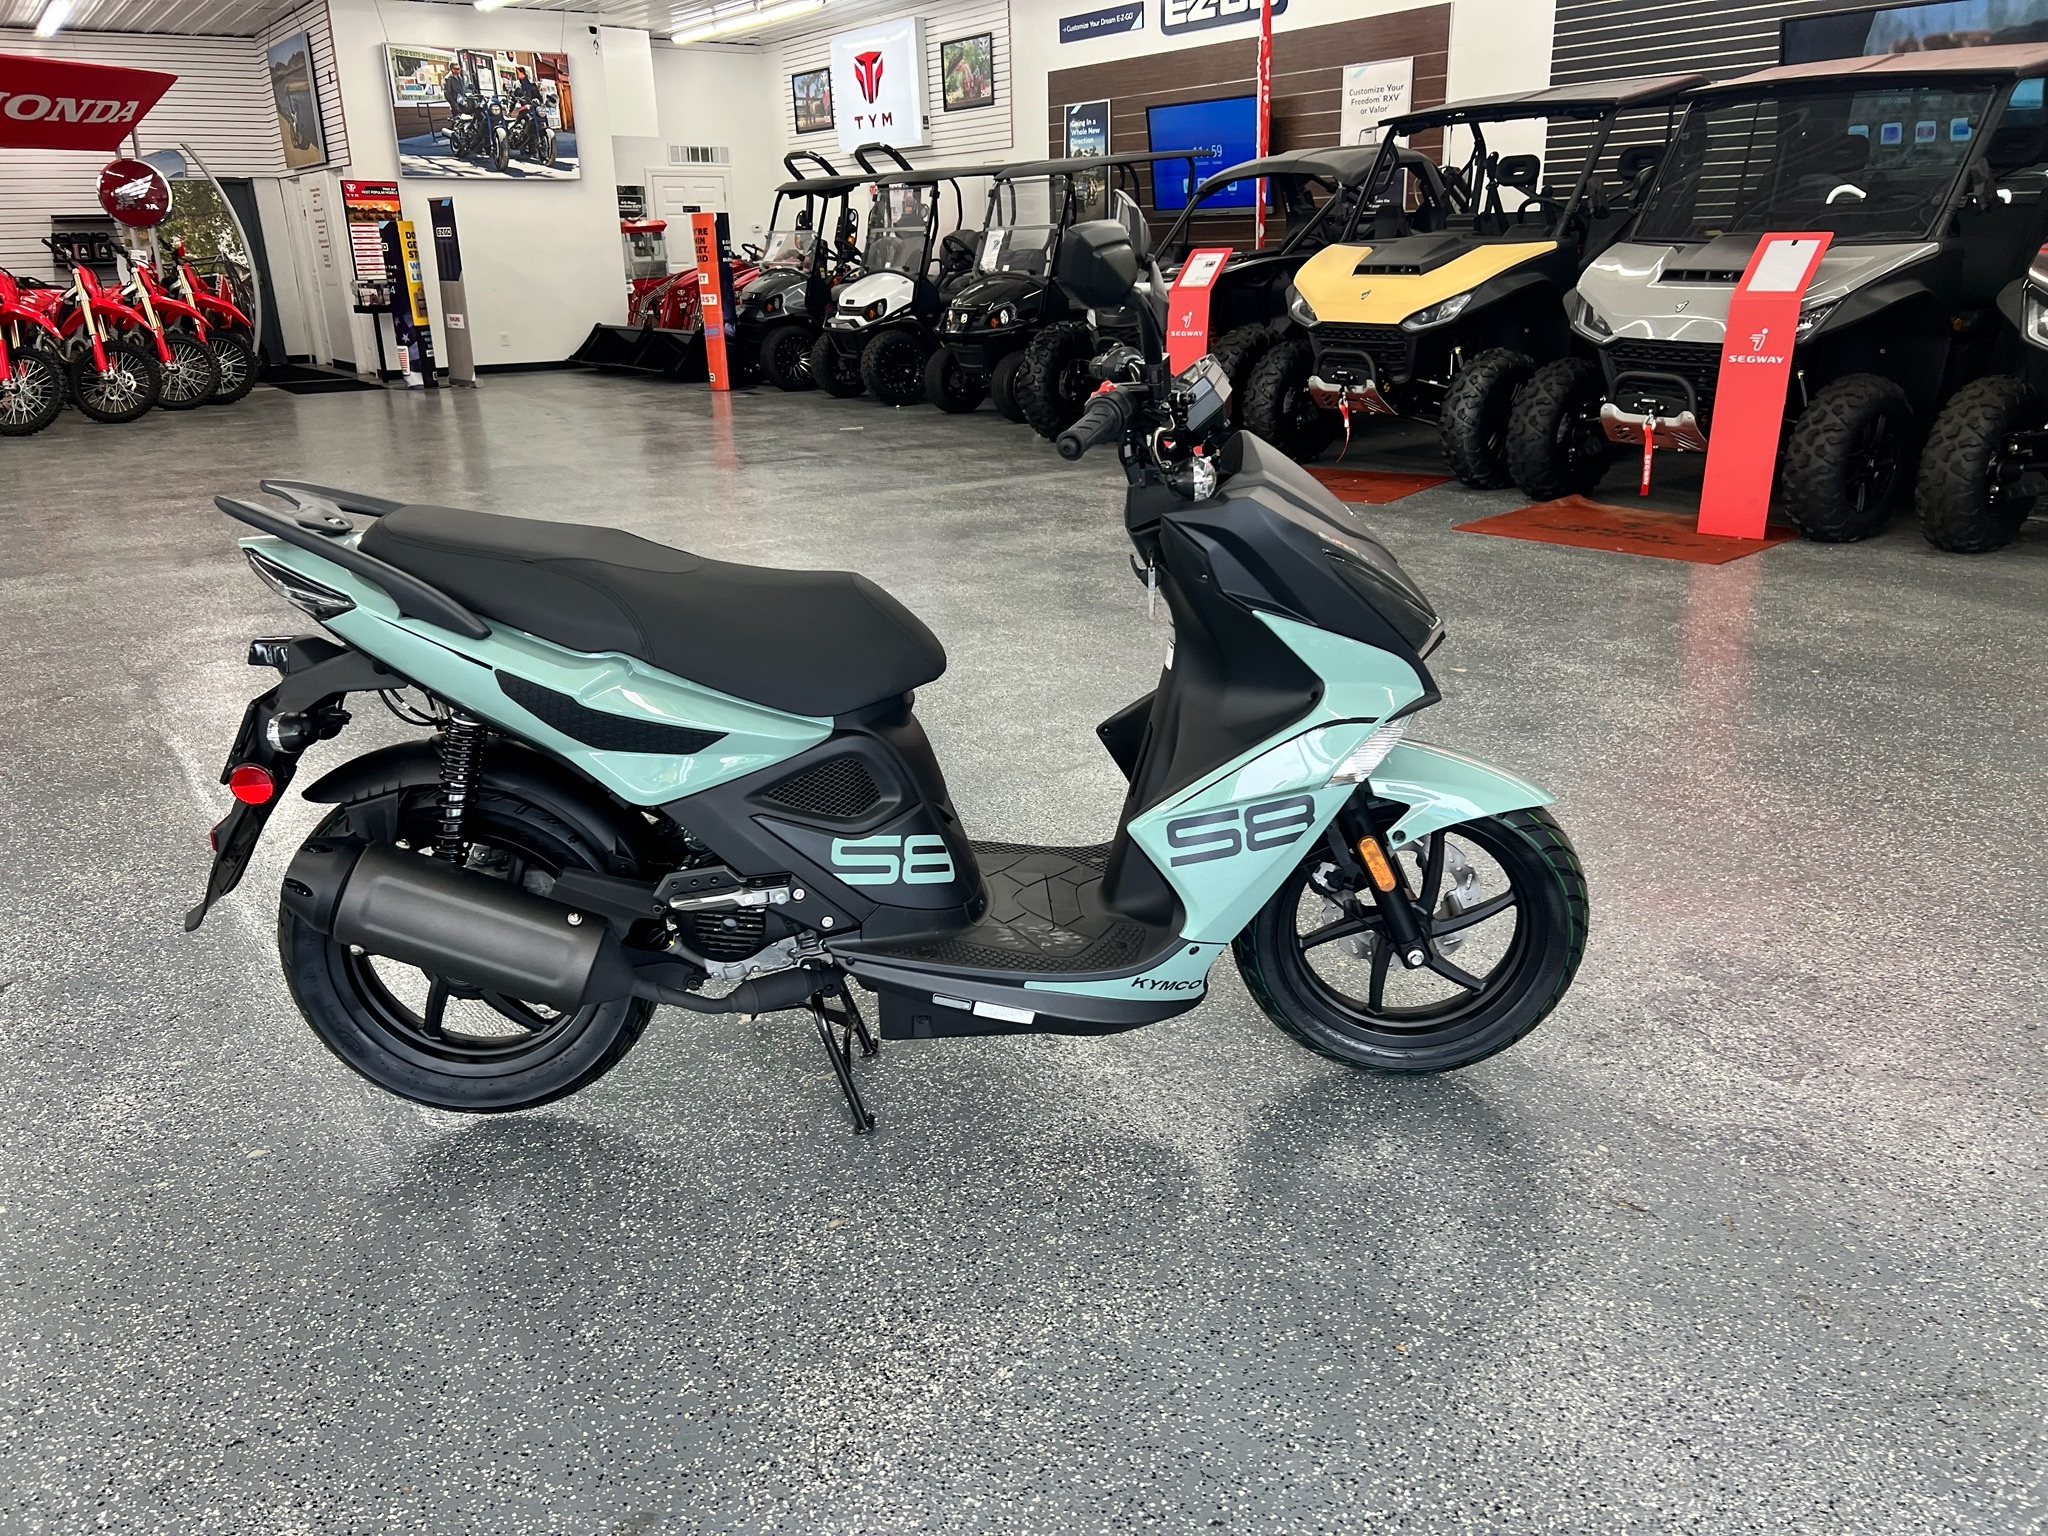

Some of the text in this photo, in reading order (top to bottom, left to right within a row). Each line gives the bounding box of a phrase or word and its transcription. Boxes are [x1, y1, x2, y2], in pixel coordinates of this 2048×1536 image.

[1066, 23, 1090, 33] Customize
[1090, 20, 1100, 28] Your
[1100, 17, 1116, 26] Dream
[1349, 84, 1404, 96] Customize Your
[1350, 94, 1400, 106] Freedom RXV
[0, 92, 140, 124] ONDA
[1369, 105, 1388, 114] Valor
[854, 112, 894, 130] TYM
[1070, 128, 1088, 136] Whole
[1728, 355, 1785, 364] SEGWAY
[1166, 794, 1316, 868] S8
[831, 834, 956, 886] S8
[1131, 977, 1203, 991] KYMCO
